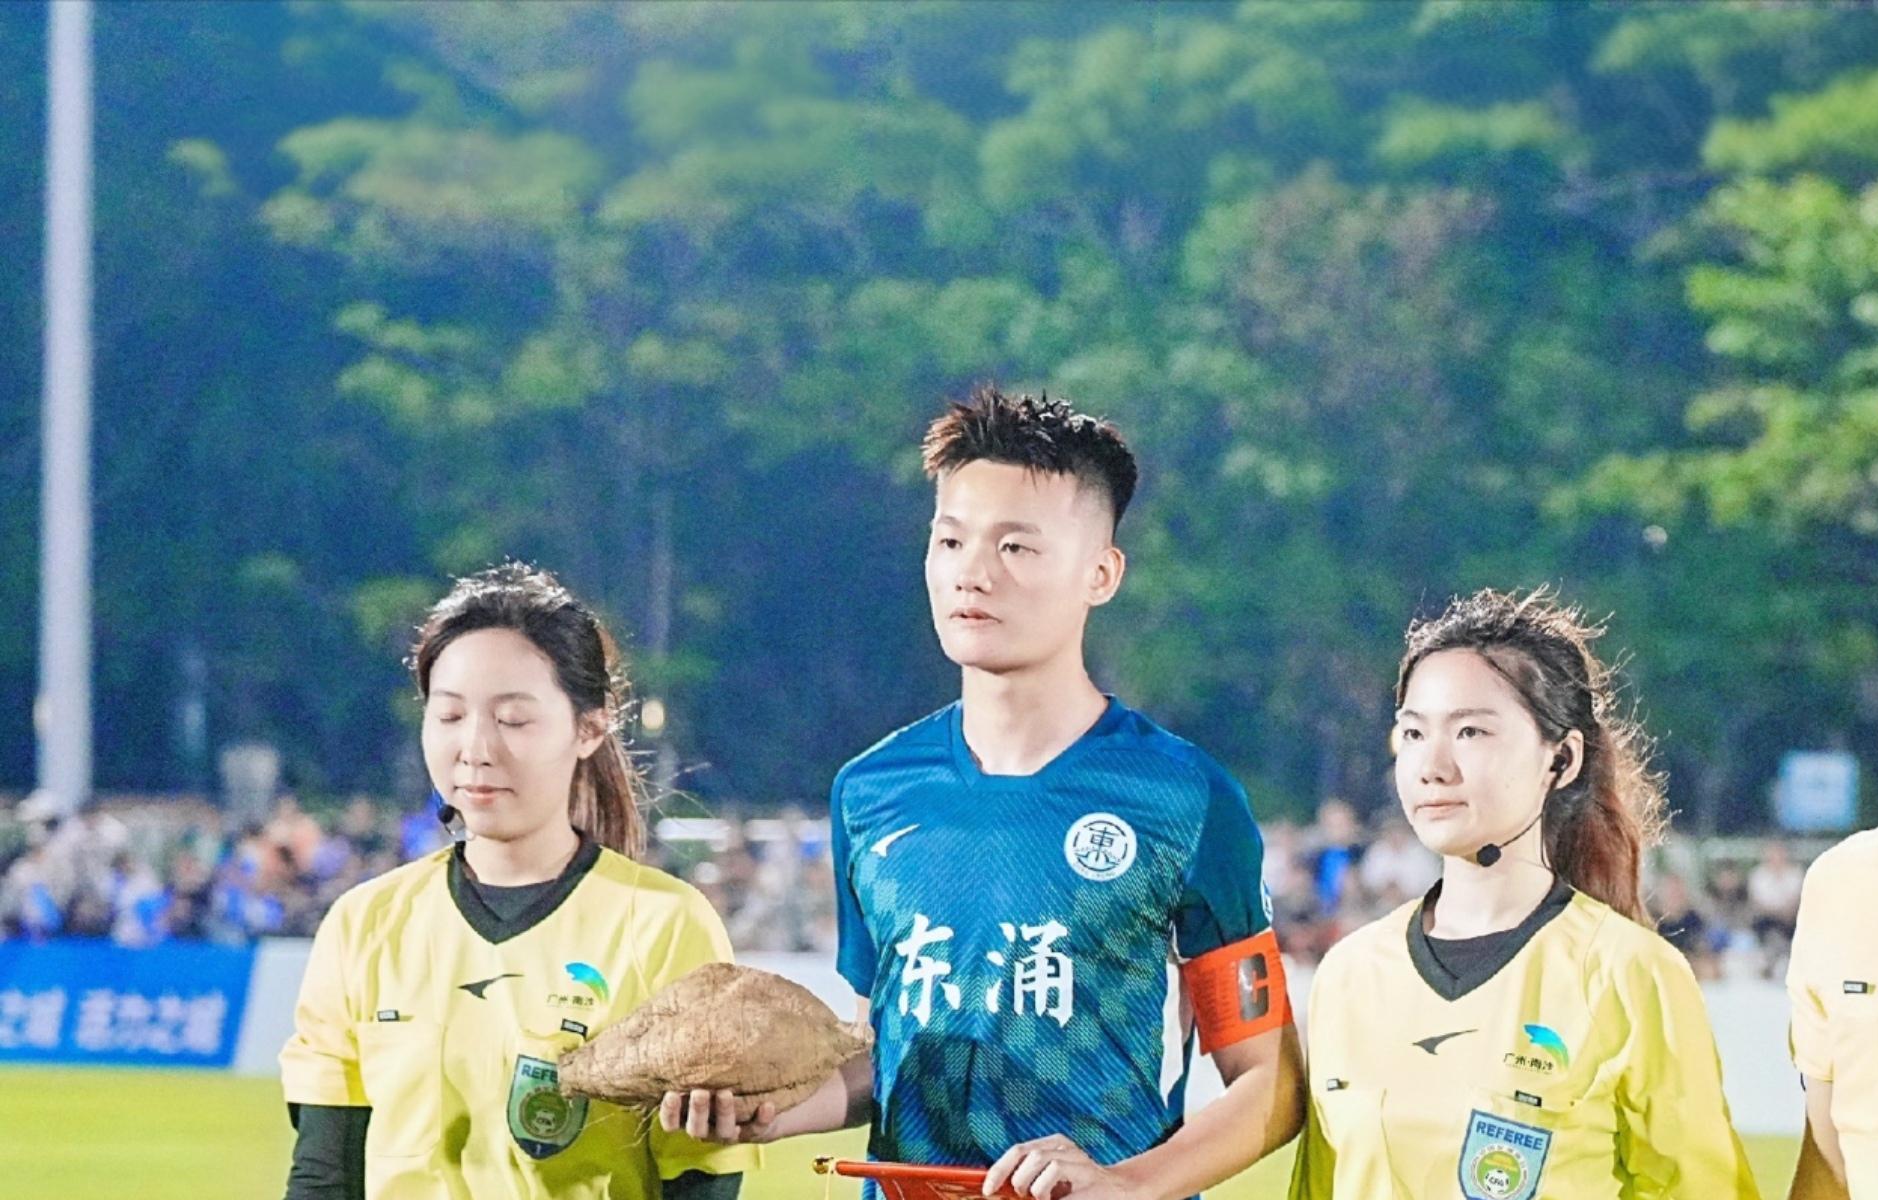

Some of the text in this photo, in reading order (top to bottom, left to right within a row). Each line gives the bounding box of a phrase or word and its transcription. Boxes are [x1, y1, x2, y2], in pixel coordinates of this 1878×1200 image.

[895, 912, 1074, 1029] 东涌
[1237, 952, 1270, 1022] C
[520, 1063, 559, 1084] REFE
[1475, 1120, 1544, 1151] REFEREE
